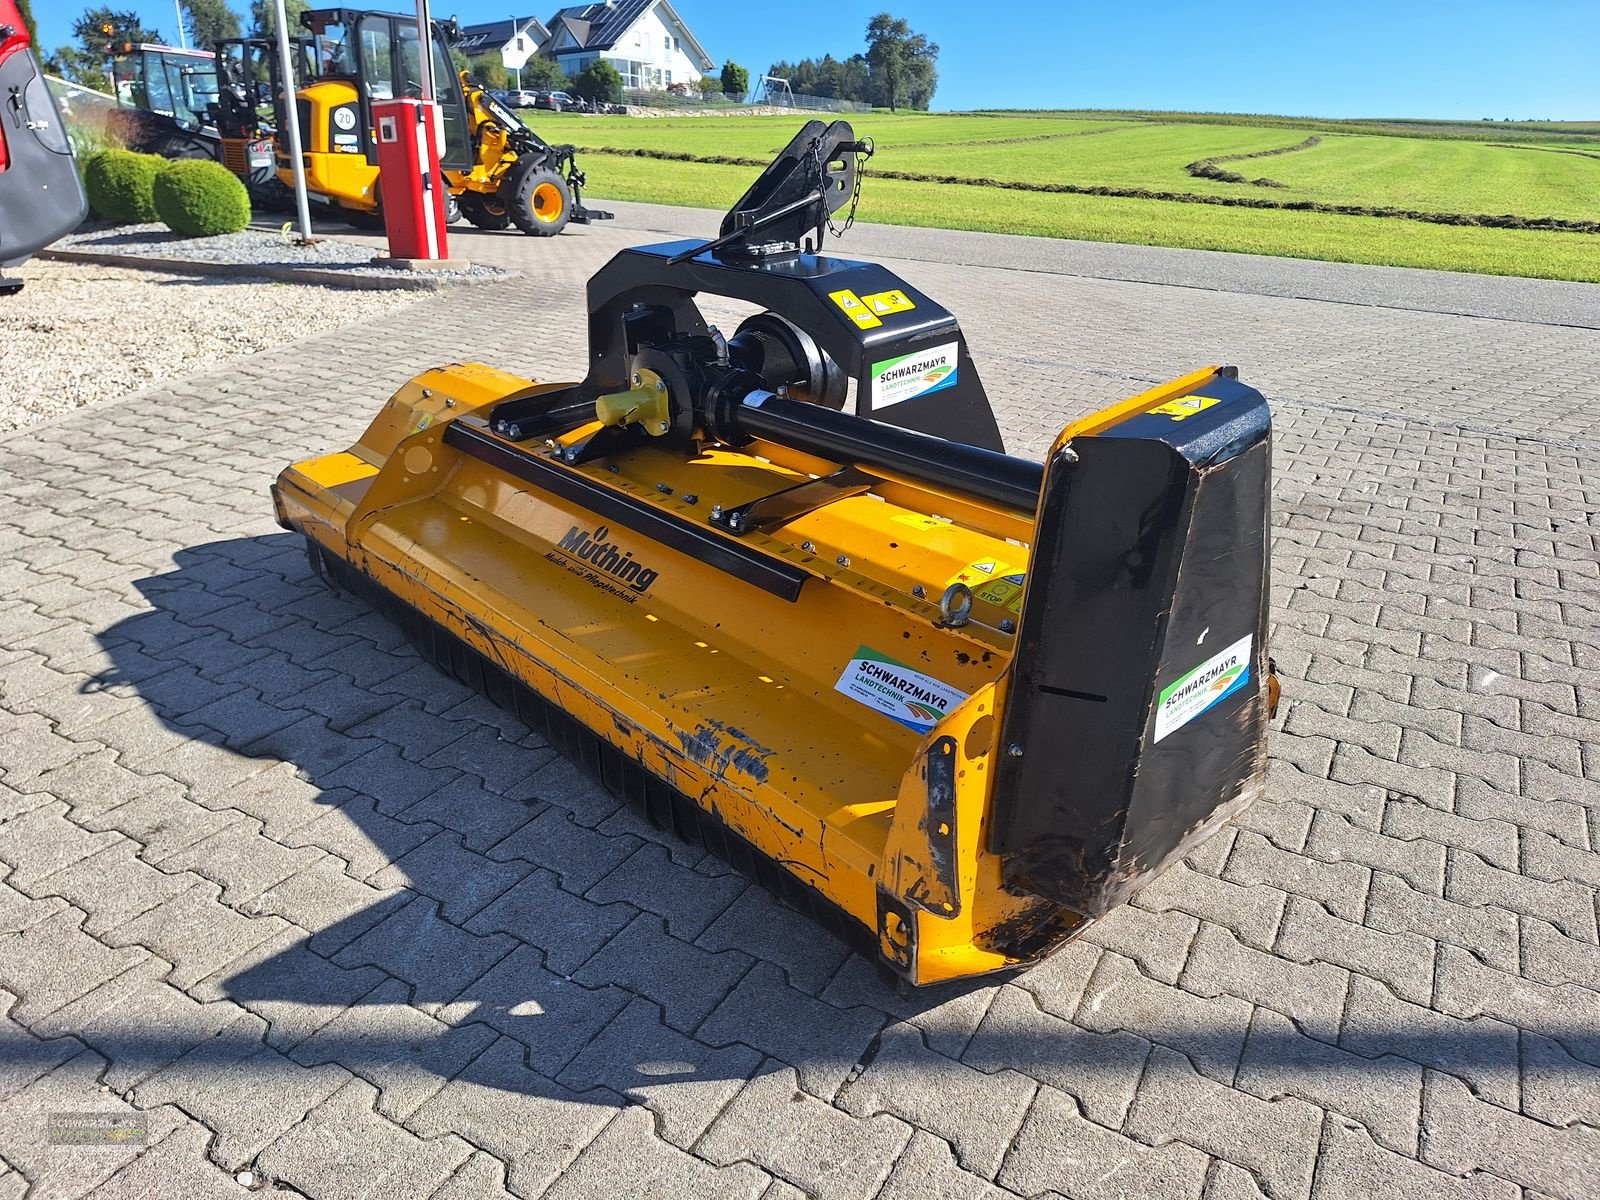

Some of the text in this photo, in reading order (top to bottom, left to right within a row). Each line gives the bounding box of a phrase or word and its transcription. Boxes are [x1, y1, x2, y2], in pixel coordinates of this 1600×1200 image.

[339, 113, 351, 124] 20
[880, 356, 947, 383] SCHWARZMAYR
[881, 376, 920, 392] LANDTECHNIK
[584, 572, 638, 605] Pflegetechnik
[980, 591, 1003, 603] STOP
[854, 673, 906, 703] LANDTECHNIK
[858, 660, 948, 710] SCHWARZMAYR
[1165, 655, 1237, 709] SCHWARZMAYR
[1165, 687, 1208, 718] LANDTECHNIK
